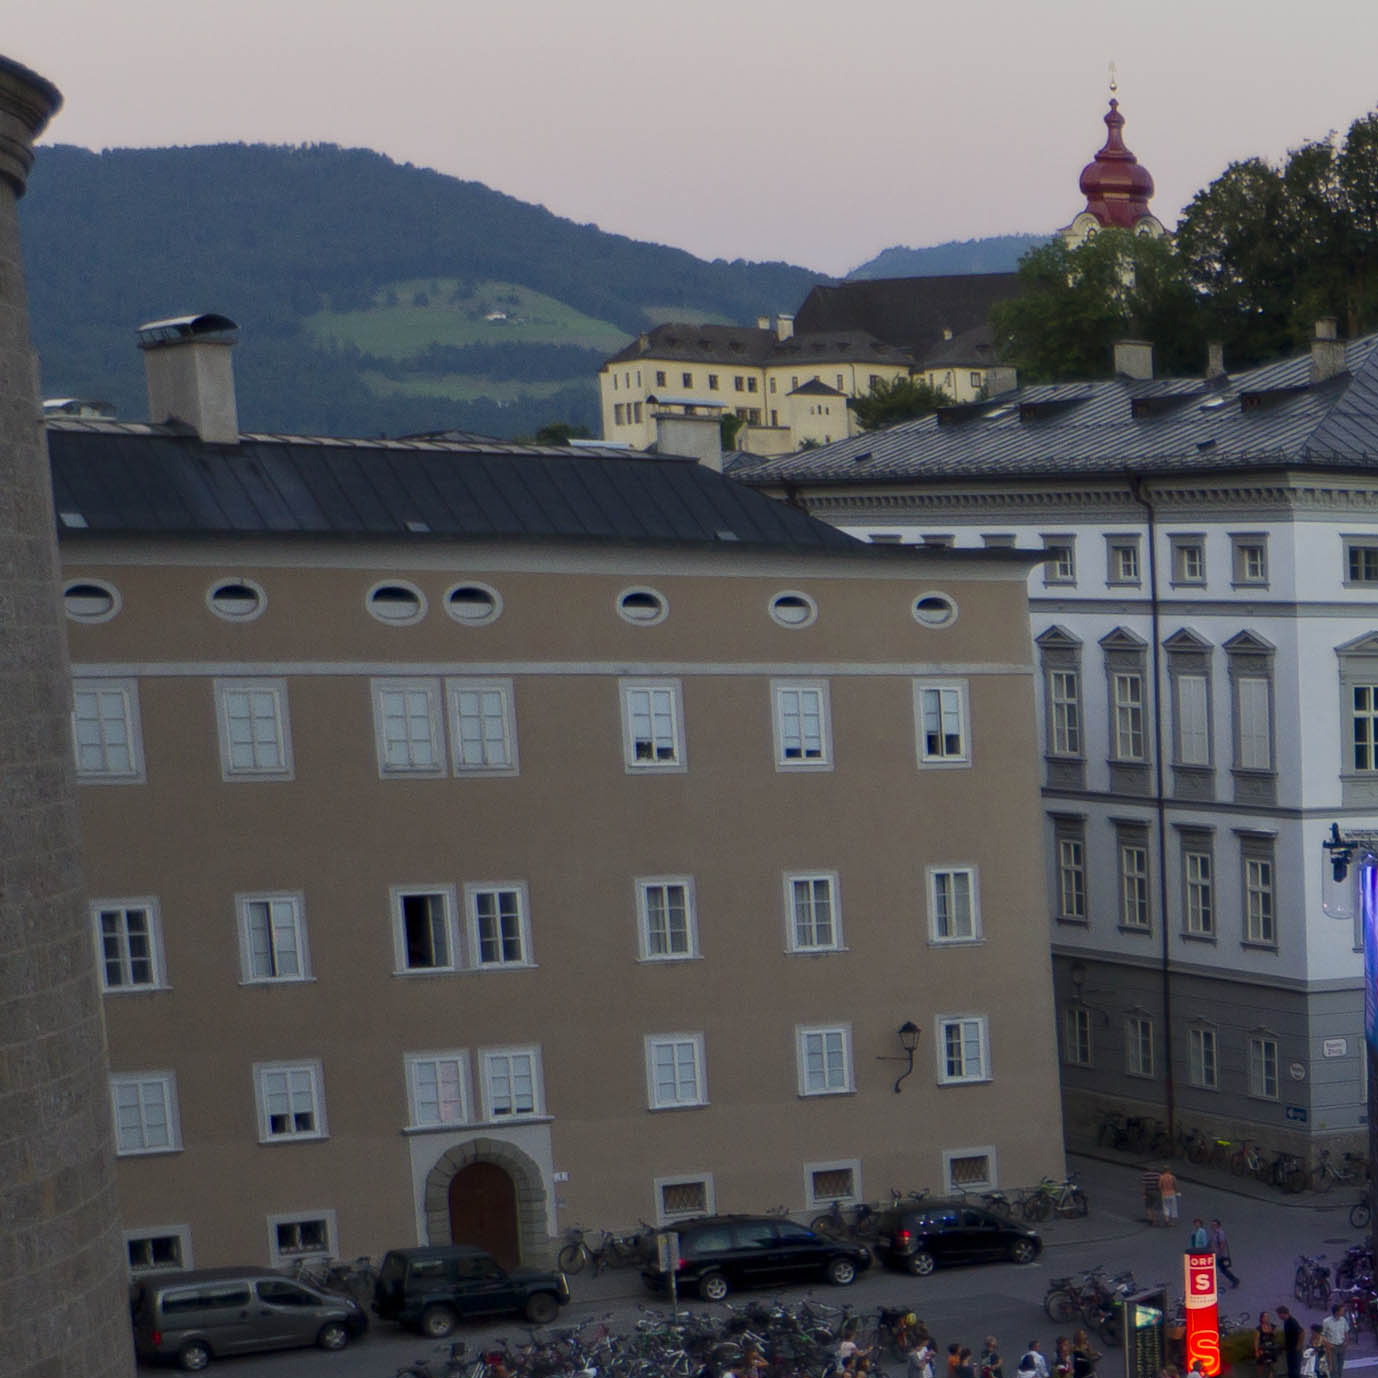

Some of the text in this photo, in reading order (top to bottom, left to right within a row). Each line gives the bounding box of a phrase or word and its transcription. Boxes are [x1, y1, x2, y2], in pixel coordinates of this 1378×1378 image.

[1191, 1257, 1213, 1266] ORF
[1195, 1274, 1210, 1290] S
[1189, 1330, 1220, 1375] S
